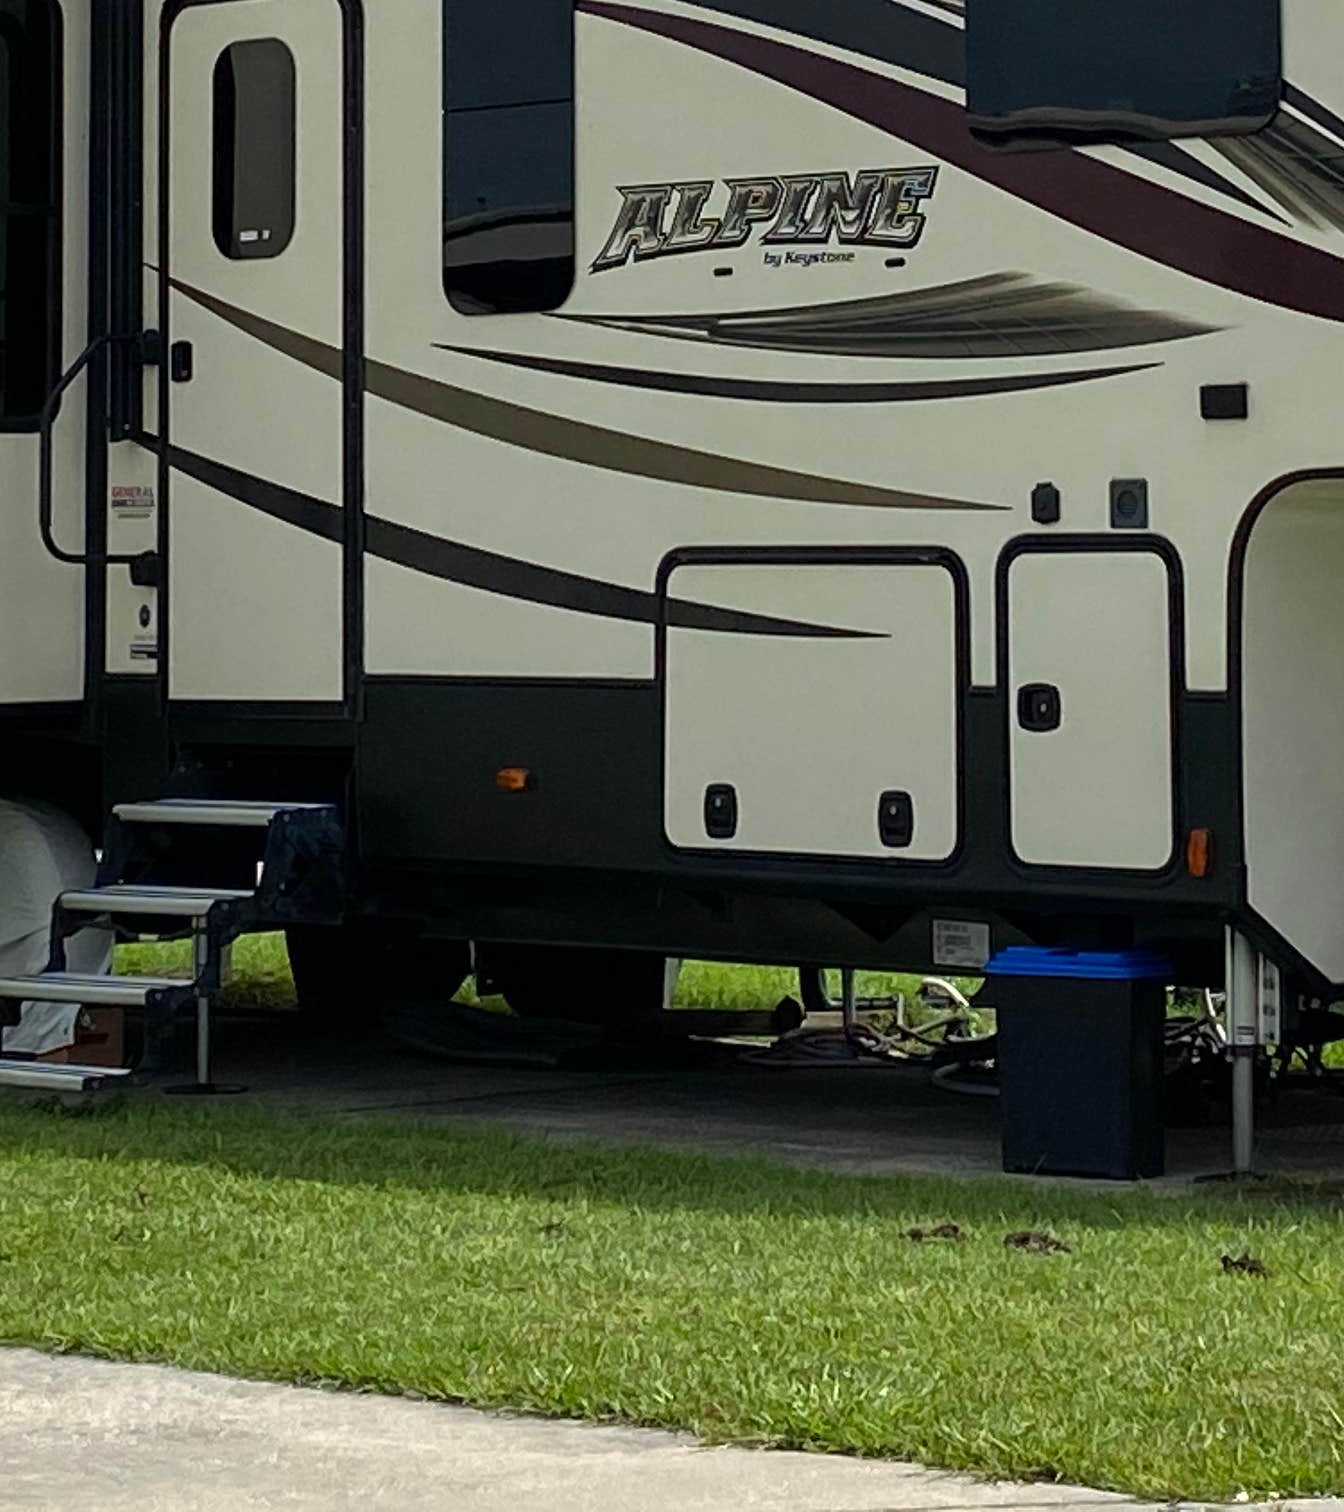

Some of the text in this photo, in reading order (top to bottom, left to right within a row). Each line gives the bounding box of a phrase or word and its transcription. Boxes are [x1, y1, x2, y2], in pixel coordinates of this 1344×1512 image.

[588, 166, 940, 275] ALPINE
[764, 252, 855, 267] by Keystone
